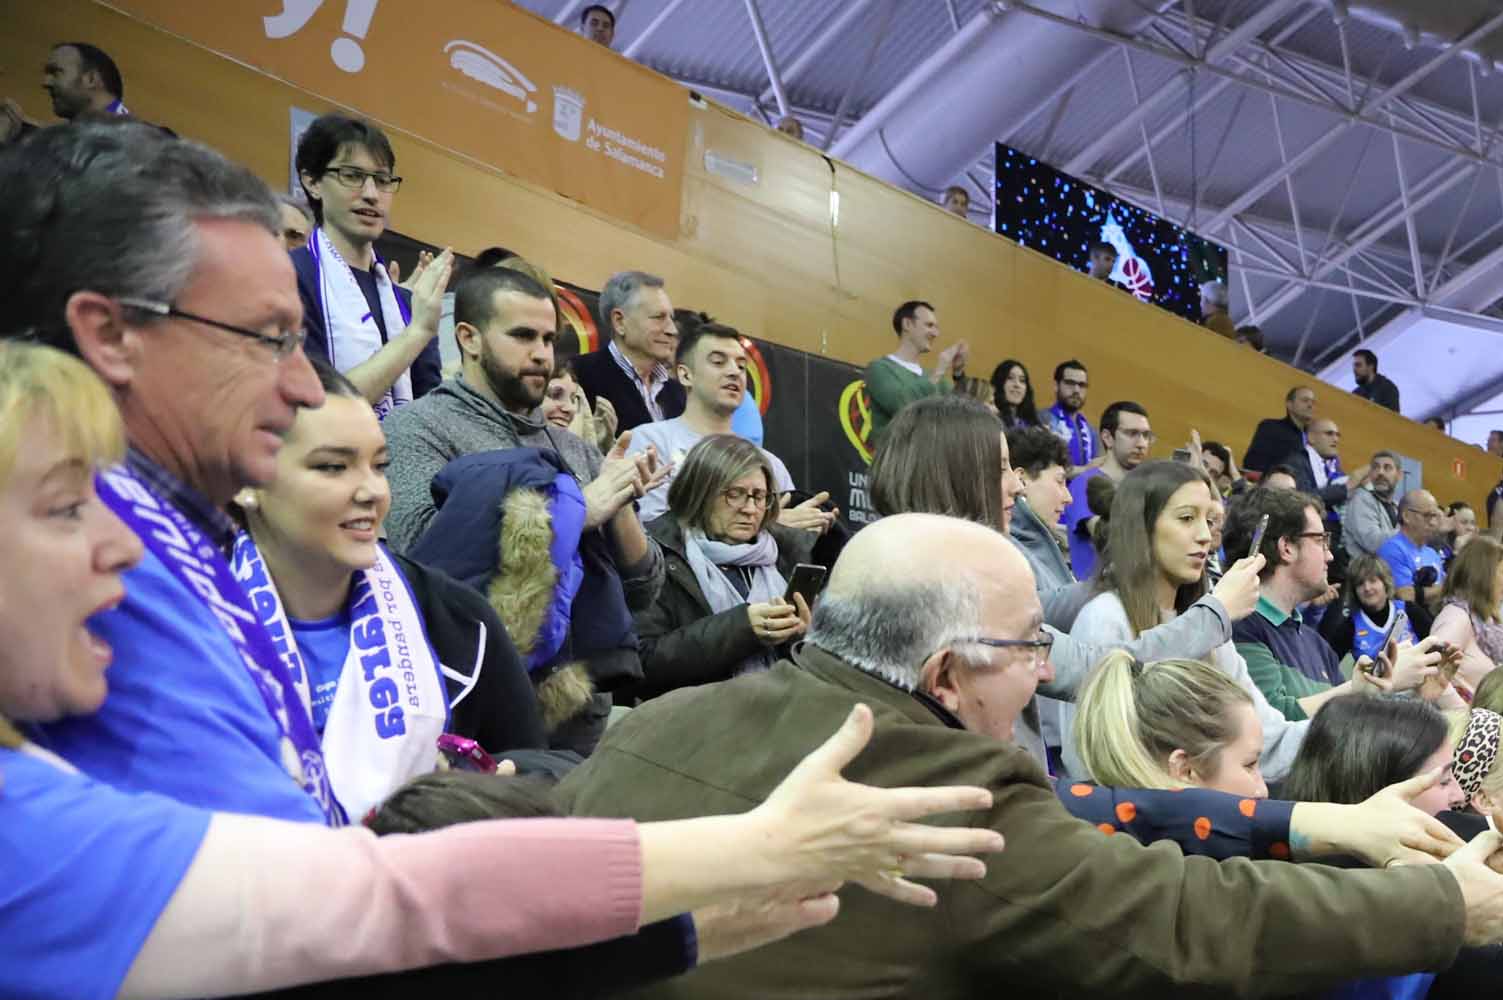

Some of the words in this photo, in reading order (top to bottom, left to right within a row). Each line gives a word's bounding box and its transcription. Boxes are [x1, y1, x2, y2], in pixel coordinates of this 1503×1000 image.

[585, 135, 601, 152] de
[603, 142, 665, 178] Salamanca
[586, 119, 667, 162] Ayuntamiento
